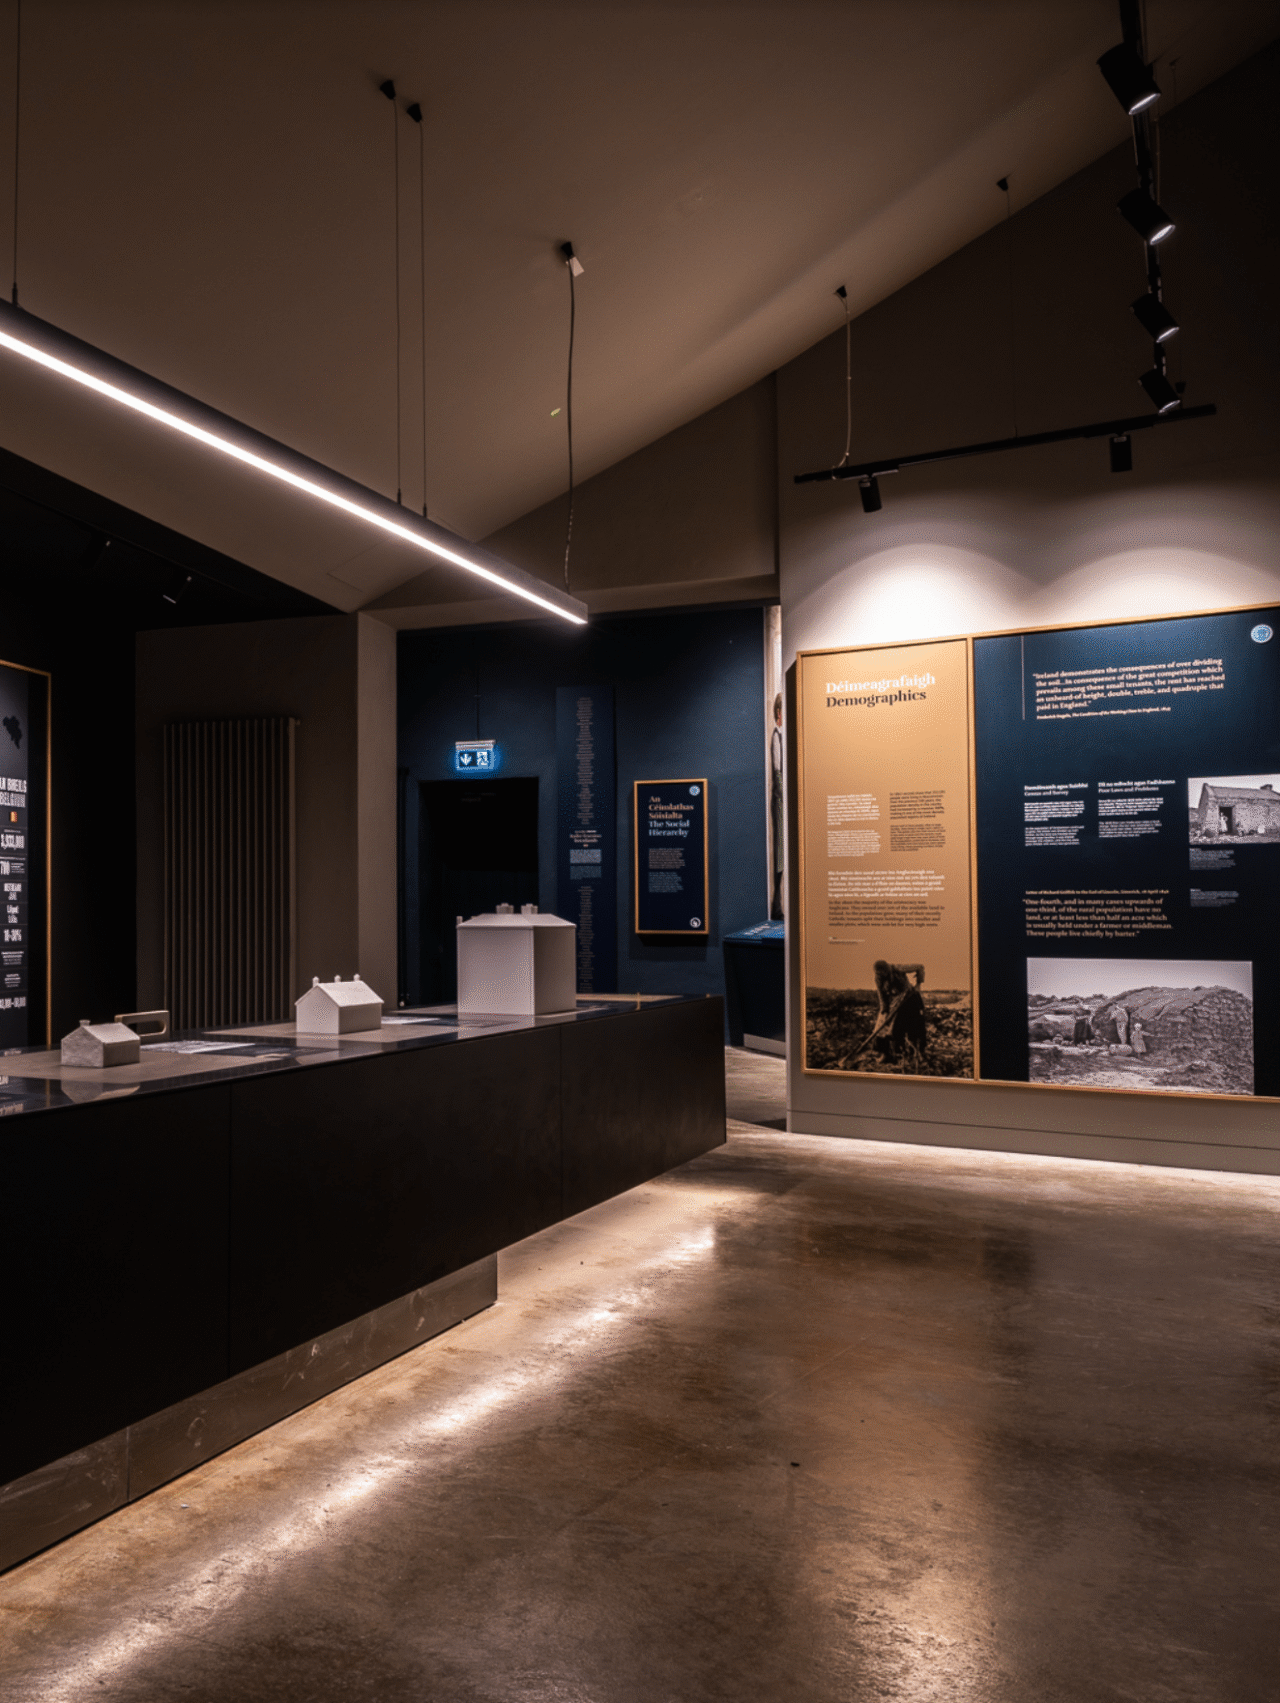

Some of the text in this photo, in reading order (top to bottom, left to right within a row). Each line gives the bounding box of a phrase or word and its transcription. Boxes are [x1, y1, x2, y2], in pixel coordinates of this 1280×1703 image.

[826, 673, 936, 694] Déimeagrafaigh
[826, 690, 926, 708] Demographics
[649, 828, 688, 837] Hierarchy
